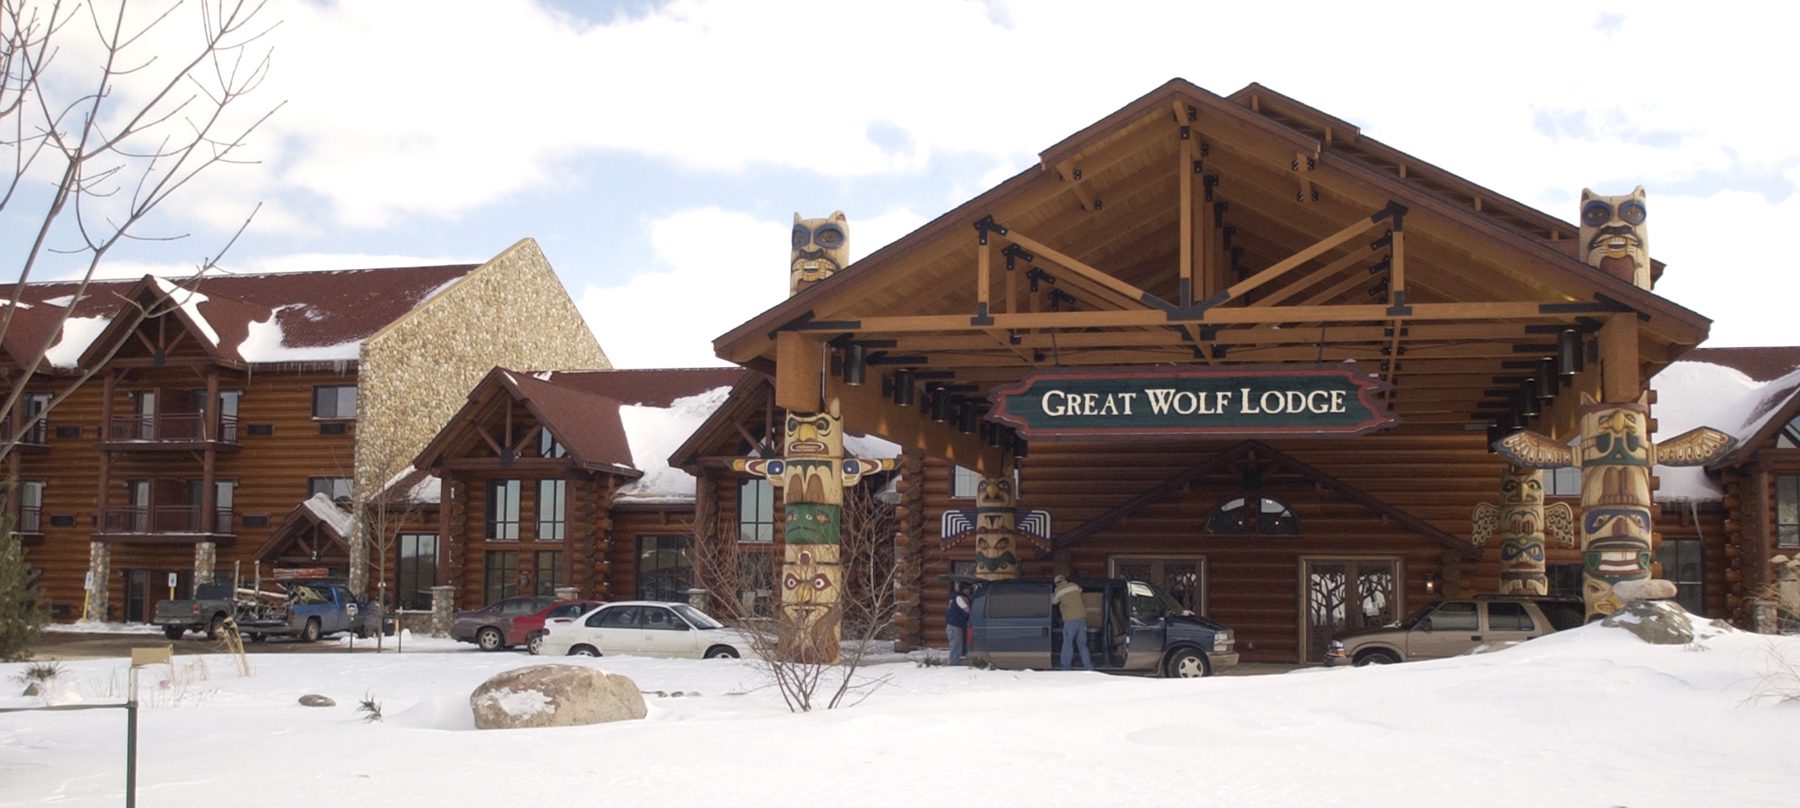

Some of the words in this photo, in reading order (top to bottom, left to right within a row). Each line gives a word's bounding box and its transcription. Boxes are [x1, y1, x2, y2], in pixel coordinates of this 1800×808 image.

[1041, 389, 1137, 417] GREAT
[1144, 388, 1233, 415] WOLF
[1240, 387, 1347, 415] LODGE
[311, 550, 318, 560] 2
